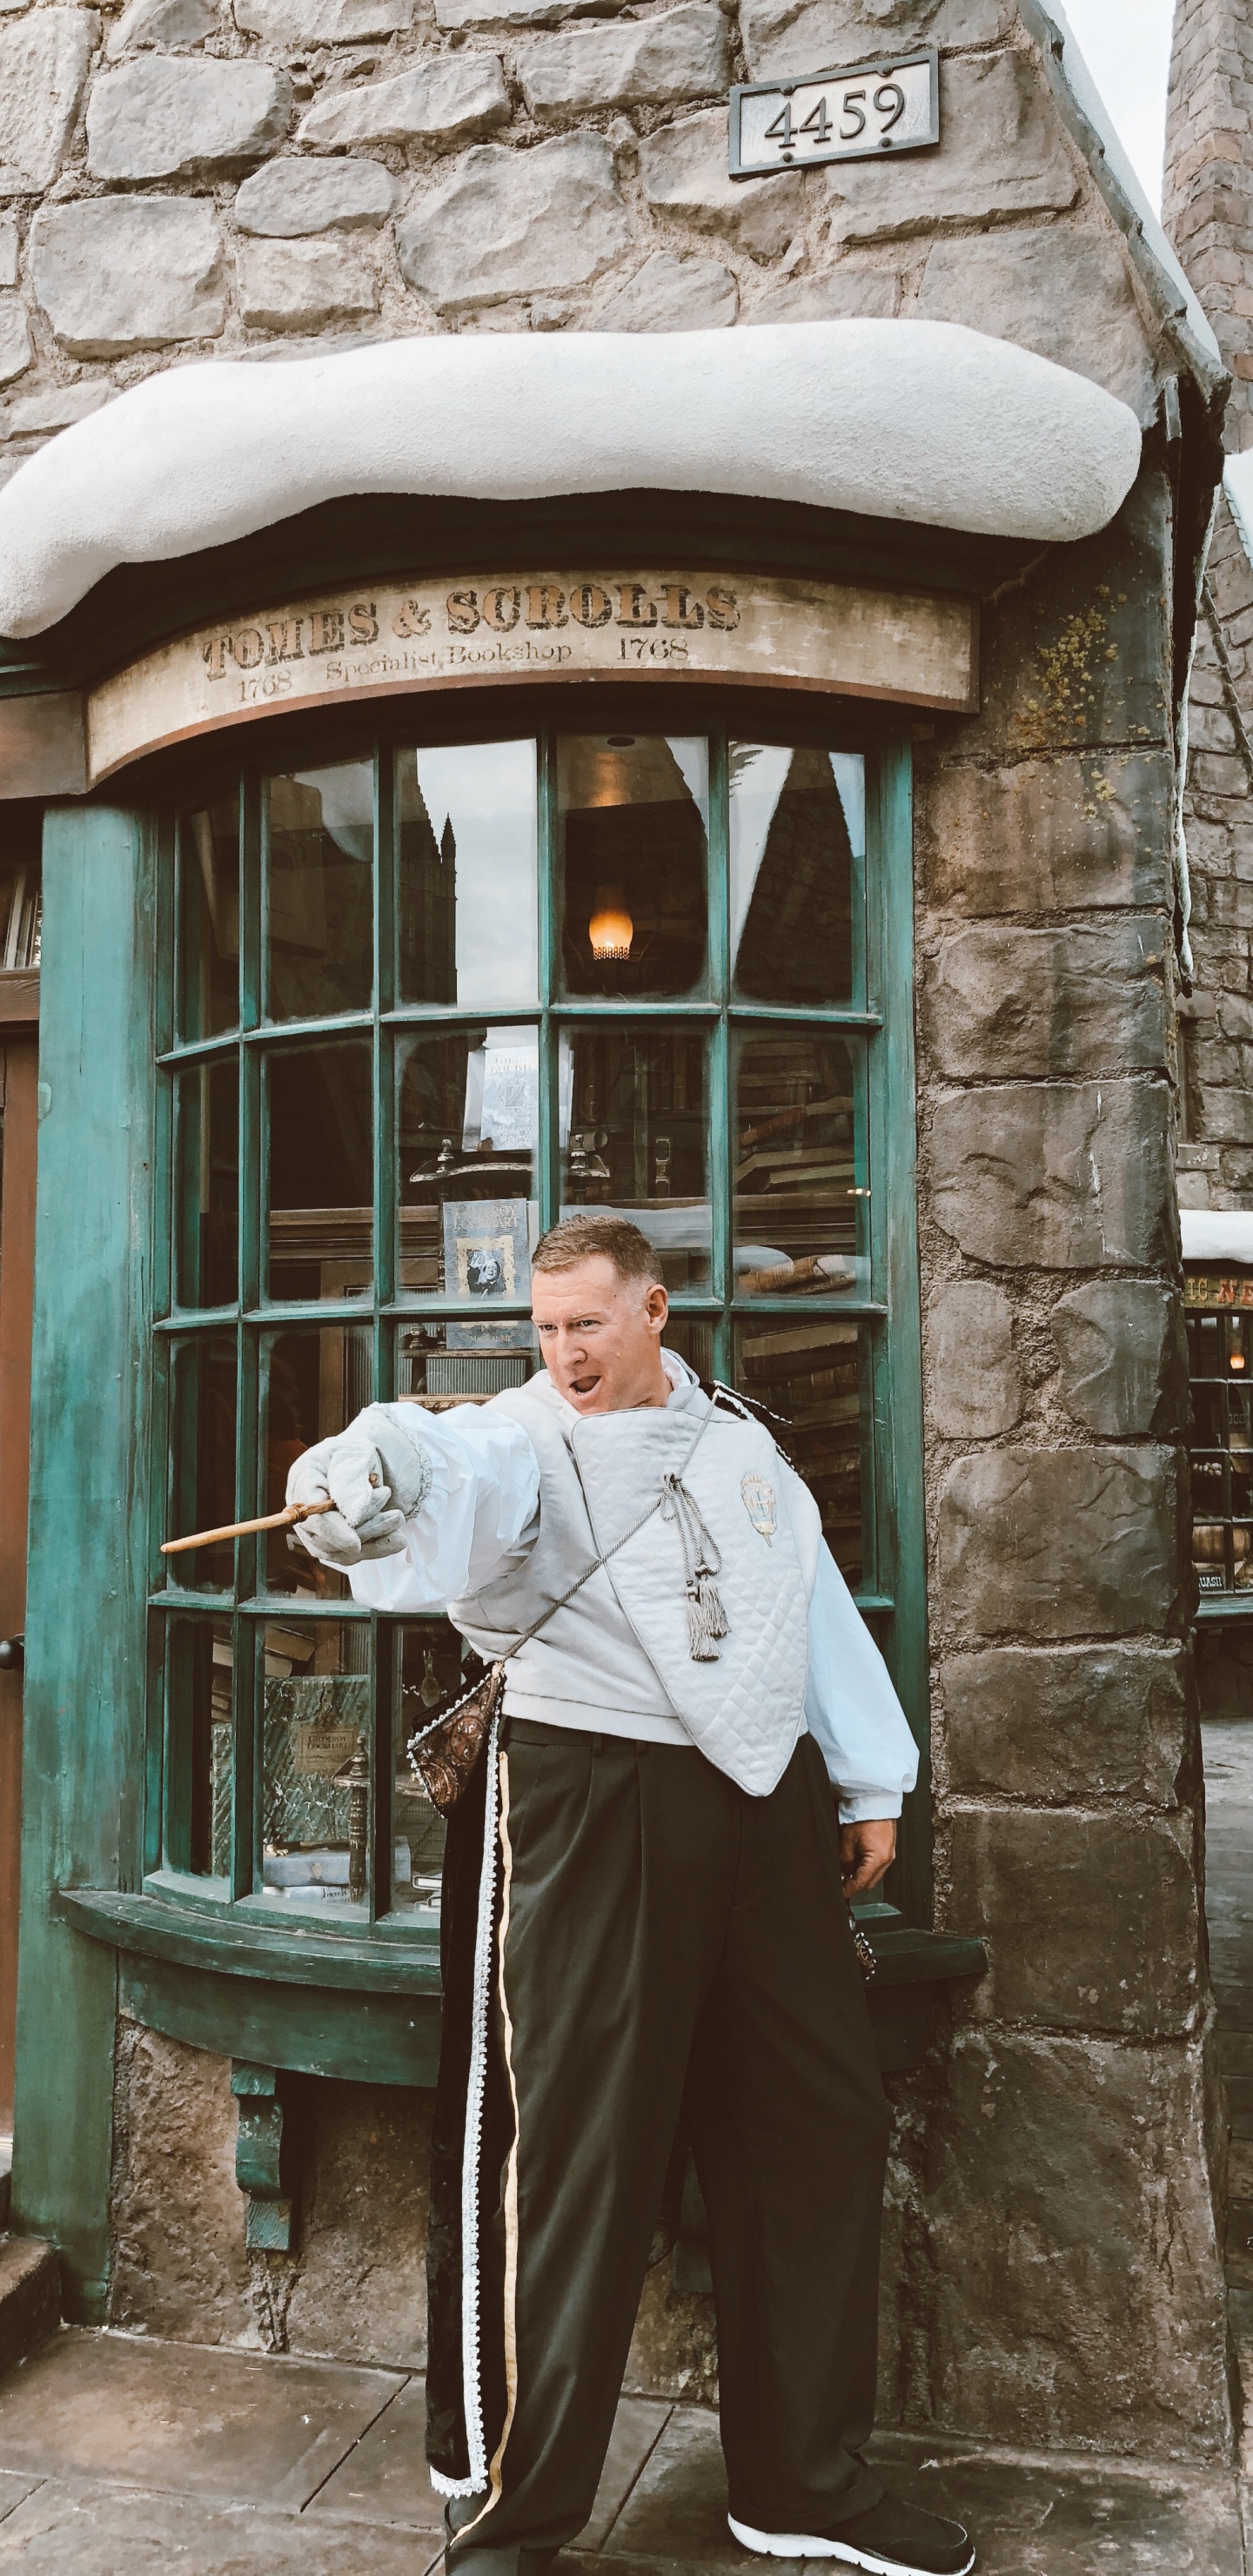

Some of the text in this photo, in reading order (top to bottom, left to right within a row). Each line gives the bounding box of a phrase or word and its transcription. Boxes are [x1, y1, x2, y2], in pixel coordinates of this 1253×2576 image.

[764, 83, 905, 149] 4459
[203, 583, 740, 682] TOMES & SCROLLS
[616, 637, 689, 661] 1768
[326, 641, 573, 683] Specialist Bookshop
[238, 668, 292, 703] 1768
[1199, 1576, 1223, 1588] UASH
